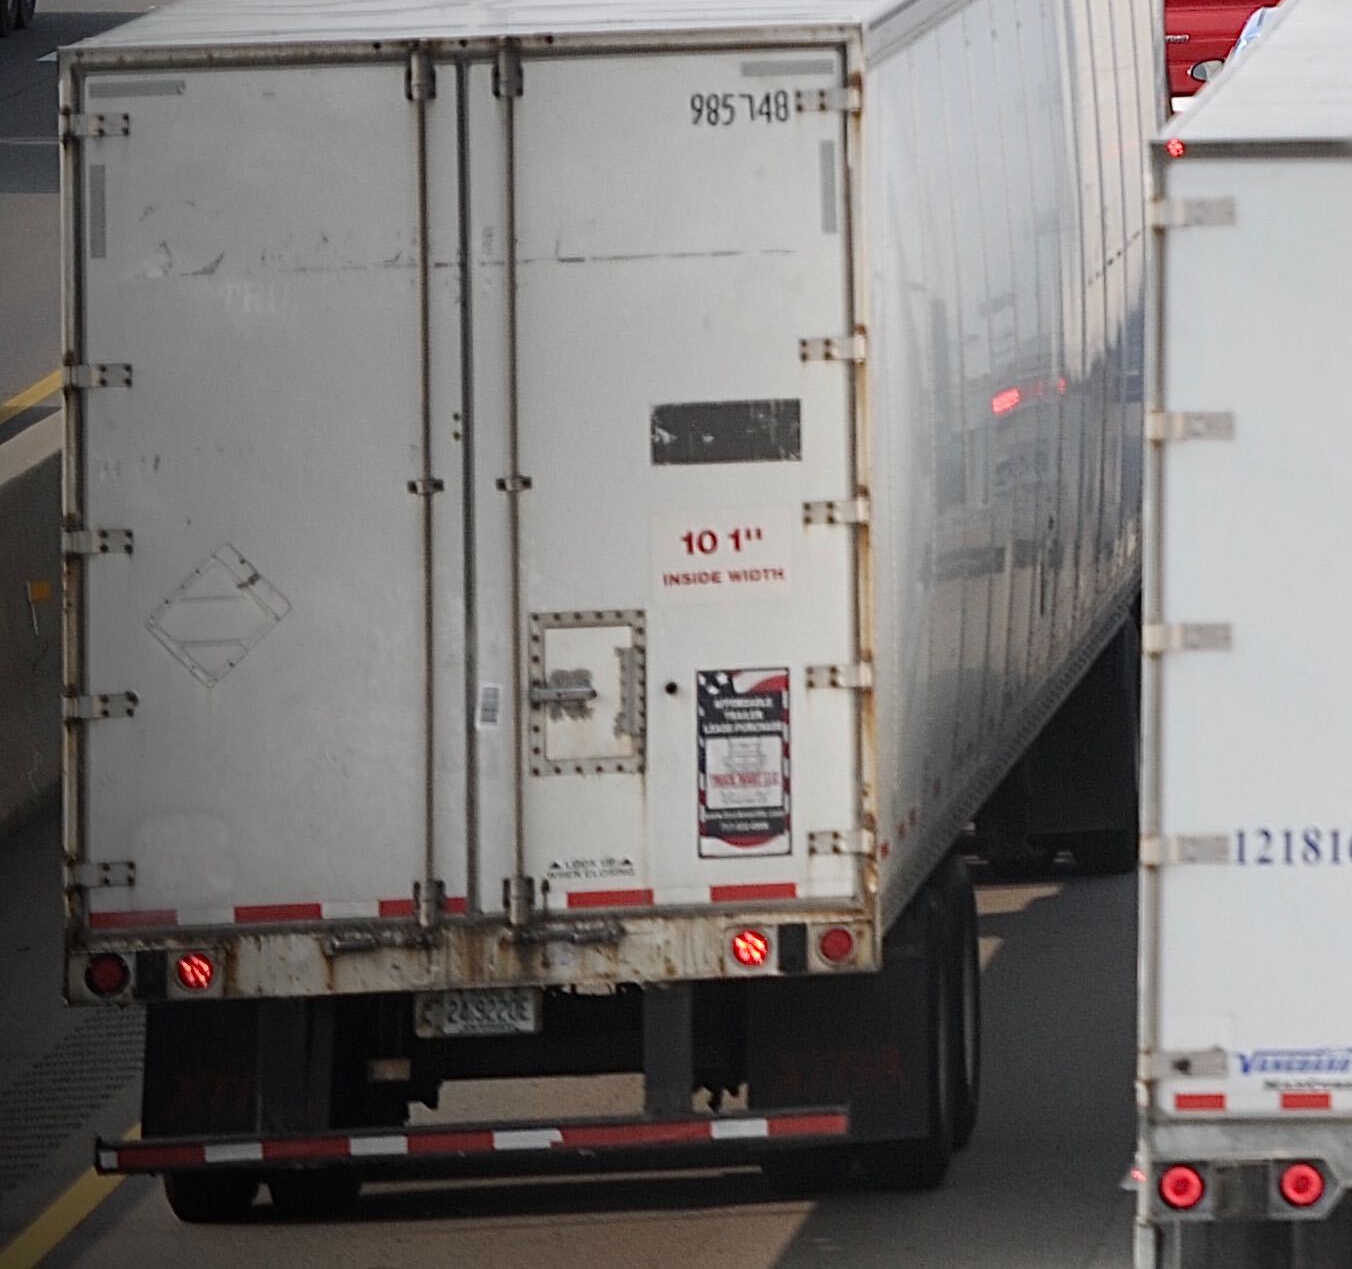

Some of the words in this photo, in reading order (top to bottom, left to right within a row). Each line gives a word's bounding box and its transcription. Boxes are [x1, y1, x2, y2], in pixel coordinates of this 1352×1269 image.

[690, 89, 790, 126] 985748
[663, 570, 722, 586] INSIDE
[729, 568, 785, 583] WIDTH
